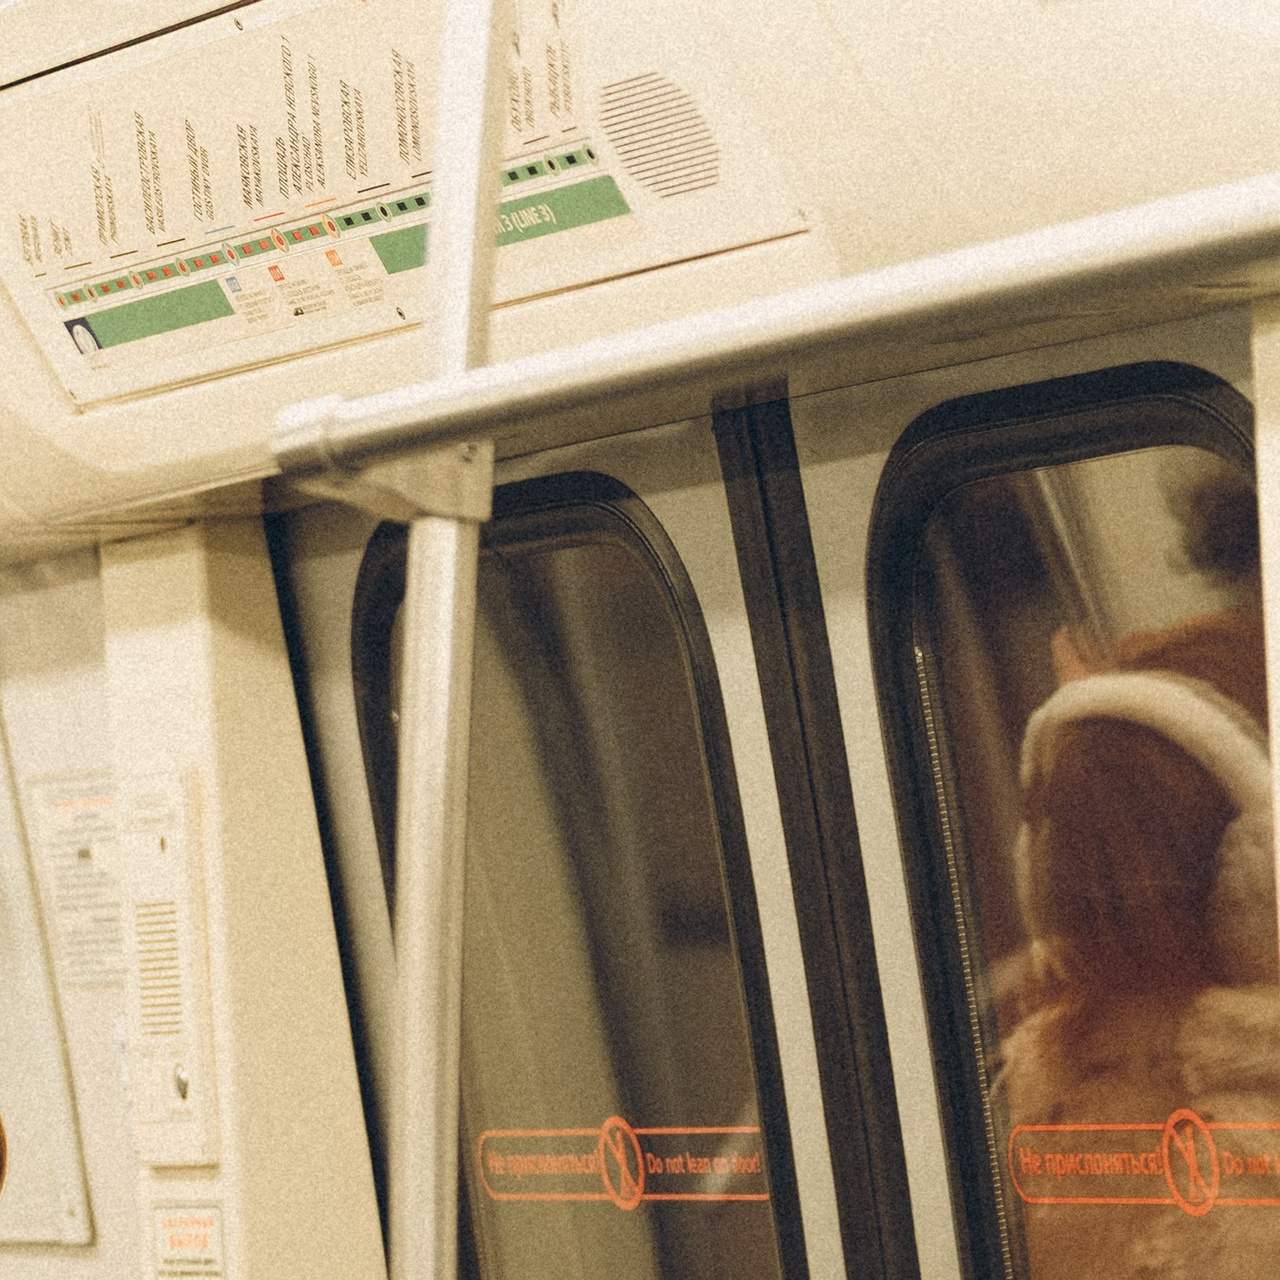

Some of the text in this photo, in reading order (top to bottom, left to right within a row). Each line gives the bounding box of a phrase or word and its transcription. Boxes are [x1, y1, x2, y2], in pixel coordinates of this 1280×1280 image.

[281, 44, 297, 112] НЕВСКОГО
[307, 61, 321, 119] NEVSKOGO
[391, 47, 411, 166] ЛОМОНОСОВСКАЯ
[406, 60, 423, 163] LOMONOSOVSKAYA
[286, 111, 303, 196] АЛЕКСАНДРА
[312, 119, 326, 190] ALEKSANDRA
[339, 78, 357, 181] ЕЛИЗАРОВСКАЯ
[236, 123, 253, 210] МАЯКОВСКАЯ
[249, 123, 264, 207] MAYAKOVSKAYA
[275, 136, 290, 200] ПЛОЩАДЬ
[500, 214, 514, 232] 3
[510, 206, 542, 234] (LINE
[538, 202, 557, 225] 3)
[487, 1149, 505, 1175] Не
[646, 1151, 663, 1175] Do
[665, 1154, 686, 1175] not
[685, 1151, 711, 1175] lean
[1018, 1145, 1164, 1183] Не прислоняться!
[1221, 1151, 1243, 1175] Do
